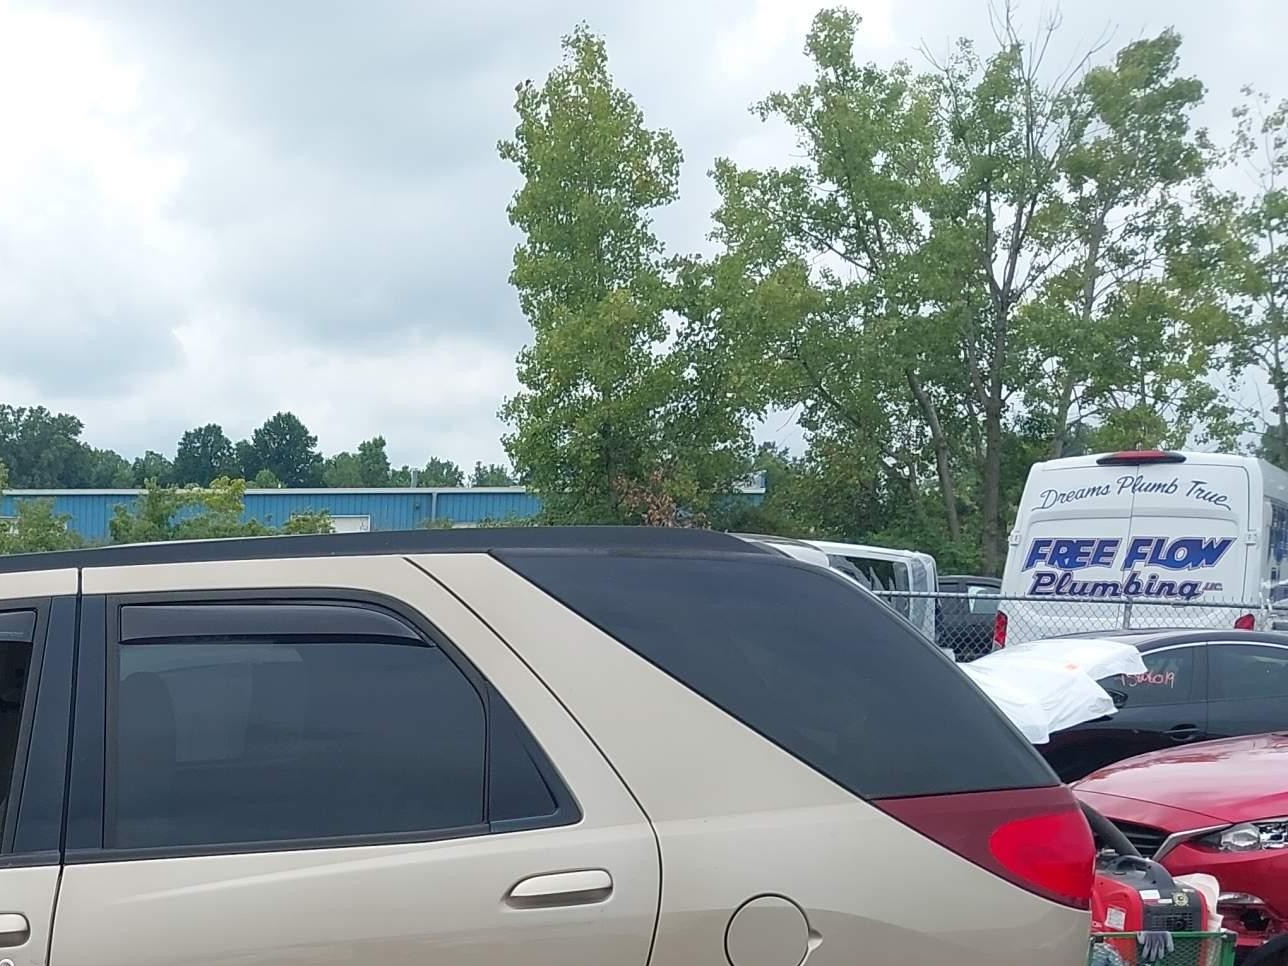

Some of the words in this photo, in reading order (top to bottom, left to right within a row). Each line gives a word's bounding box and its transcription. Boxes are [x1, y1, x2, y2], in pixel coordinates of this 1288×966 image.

[1032, 484, 1110, 511] Dreams
[1116, 475, 1178, 496] Plumb
[1185, 480, 1232, 511] True
[1022, 537, 1123, 572] FREE
[1121, 536, 1238, 573] FLOW
[1028, 570, 1203, 601] Plumbing
